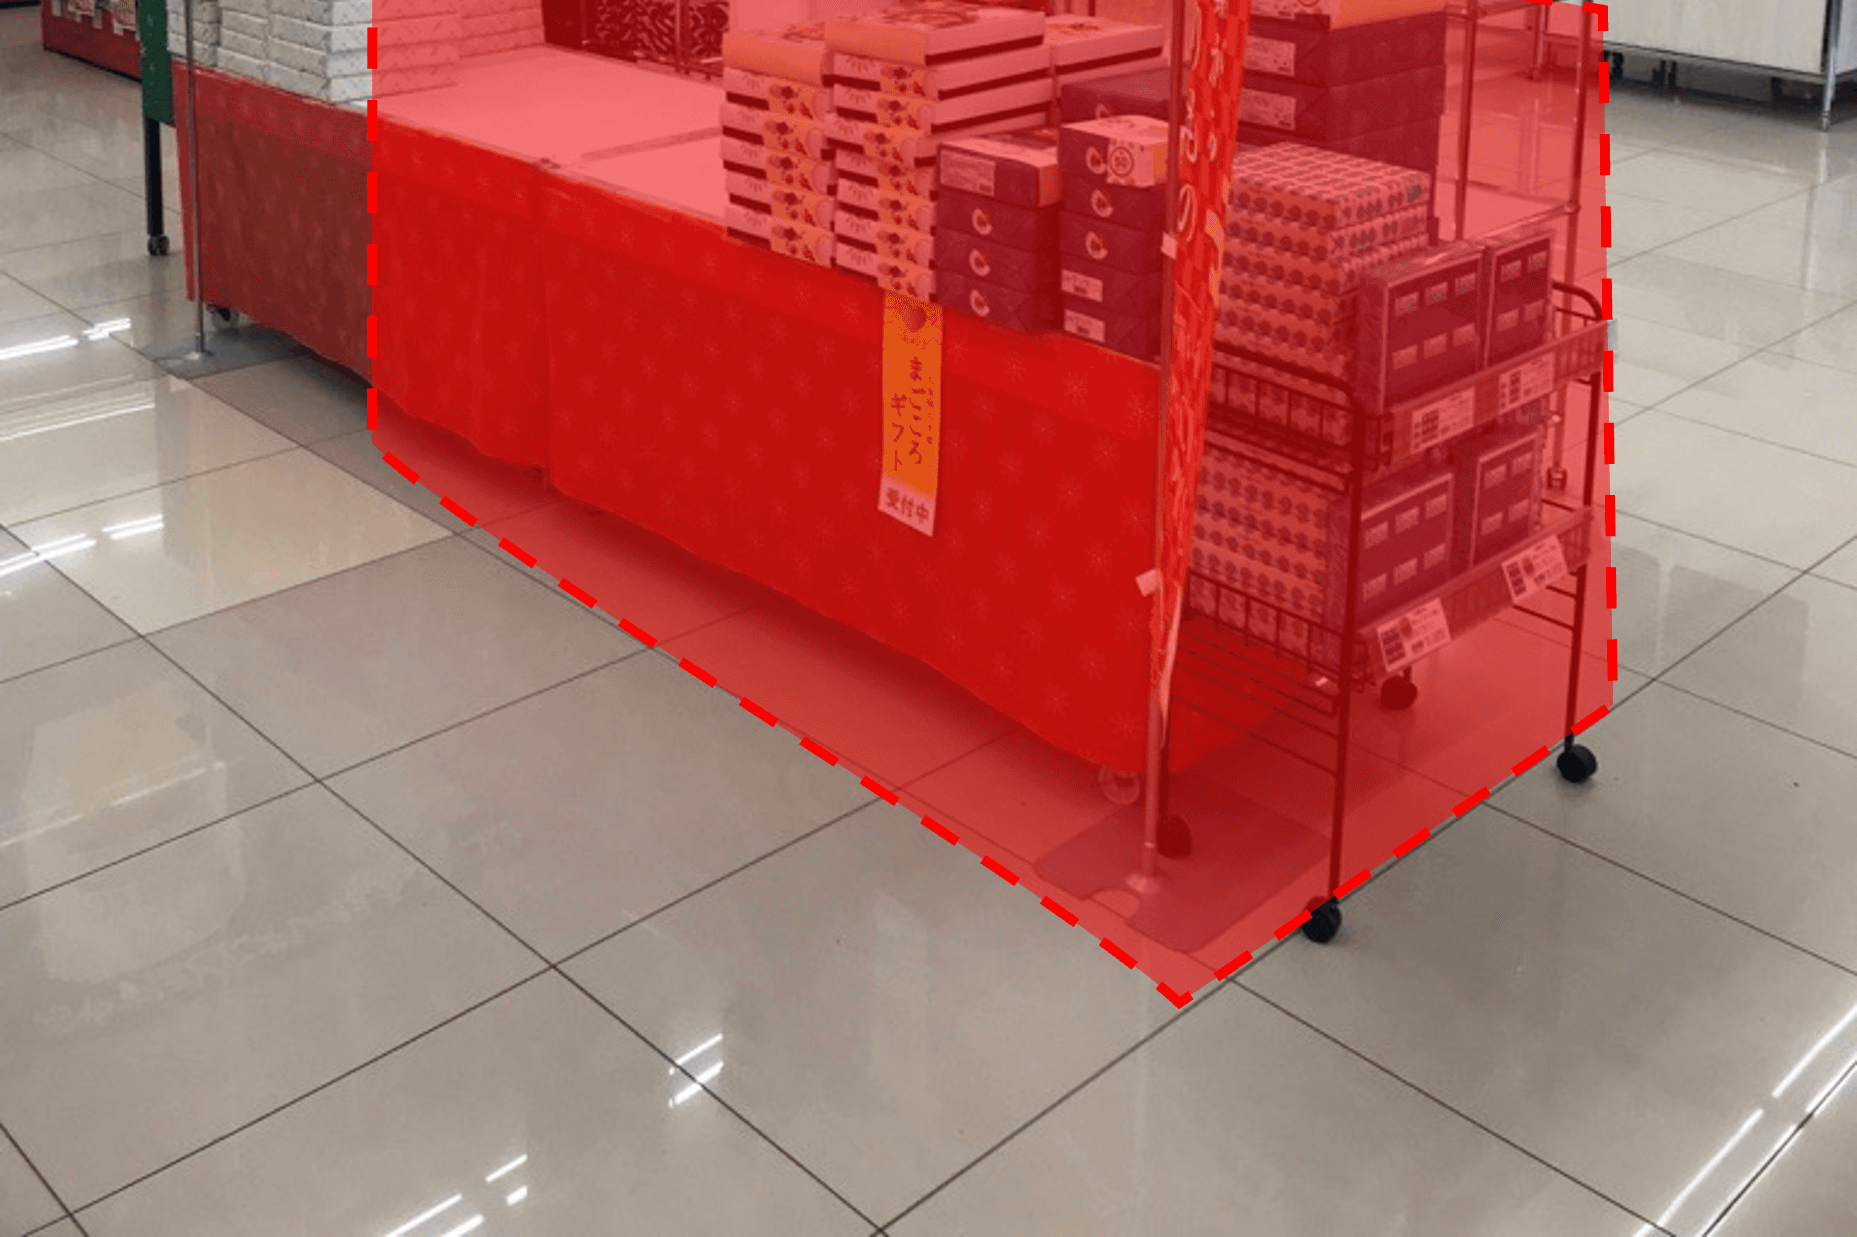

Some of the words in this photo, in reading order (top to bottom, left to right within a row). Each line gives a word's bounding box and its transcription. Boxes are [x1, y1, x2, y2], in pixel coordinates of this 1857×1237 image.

[890, 392, 908, 472] ギフト
[886, 487, 930, 525] 受付中
